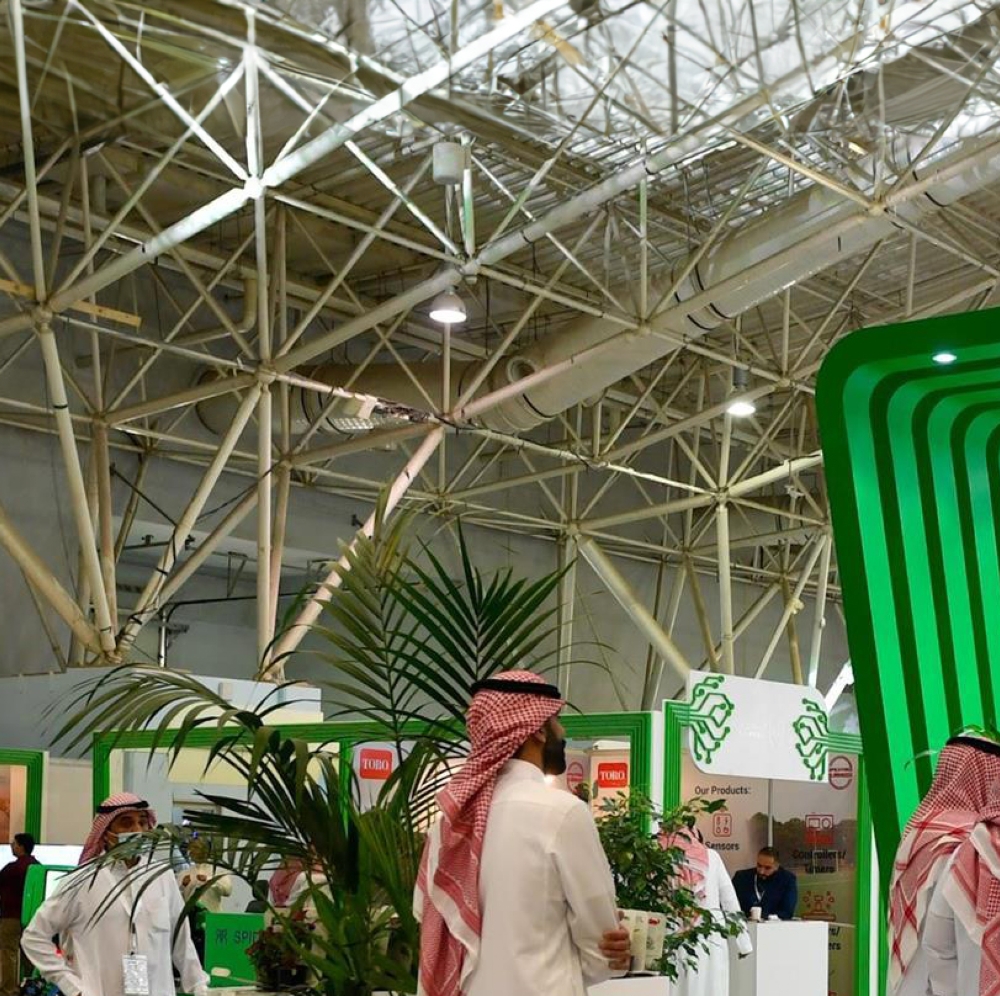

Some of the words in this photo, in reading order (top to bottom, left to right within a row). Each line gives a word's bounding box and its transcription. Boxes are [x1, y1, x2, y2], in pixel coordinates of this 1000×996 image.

[363, 758, 389, 770] TORO
[600, 770, 626, 781] TORO
[694, 785, 709, 795] Our
[705, 841, 740, 851] Sensors
